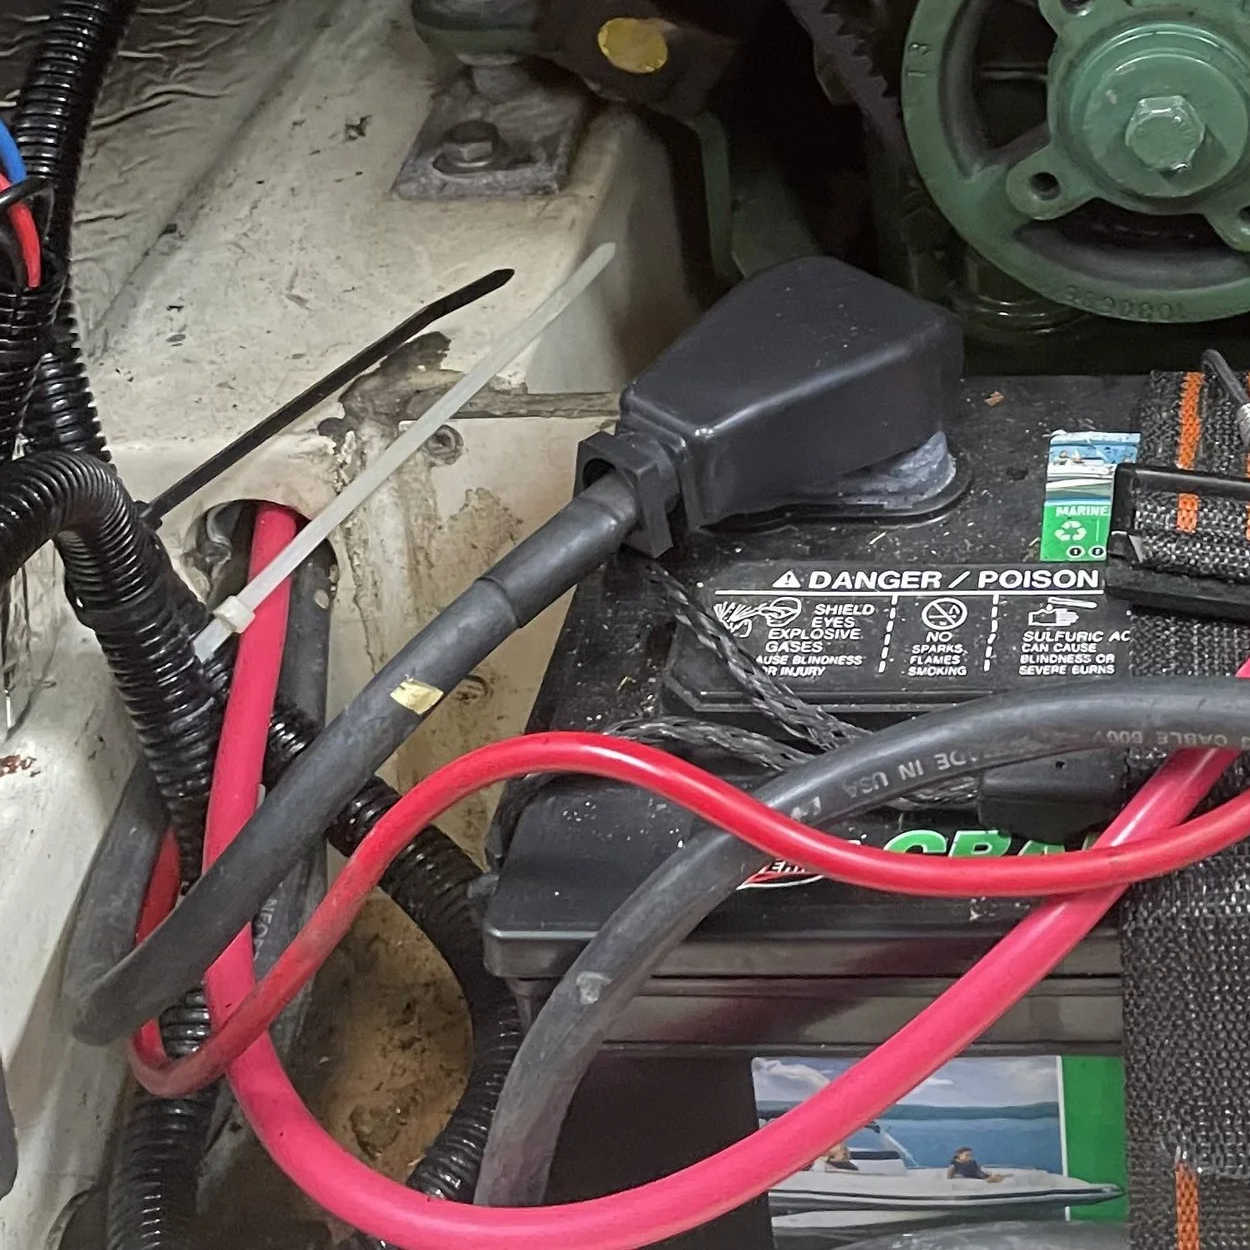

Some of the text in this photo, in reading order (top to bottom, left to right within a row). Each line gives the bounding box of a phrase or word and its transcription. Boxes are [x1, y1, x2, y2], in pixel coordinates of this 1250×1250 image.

[1055, 505, 1109, 518] MARINE
[808, 570, 943, 590] DANGER
[977, 568, 1099, 589] POISON
[814, 603, 876, 616] SHIELD
[811, 616, 855, 629] EYES
[768, 628, 862, 640] EXPLOSIVE
[926, 632, 952, 642] NO
[1022, 631, 1104, 642] SULFURIC
[765, 641, 824, 653] GASES
[1021, 644, 1096, 653] CAN CAUSE
[792, 655, 863, 665] BLINDNESS
[909, 656, 960, 665] FLAMES
[1020, 654, 1115, 664] BLINDNESS OR
[780, 667, 826, 677] INJURY
[908, 666, 968, 676] SMOKING
[1019, 665, 1115, 675] SEVERE BURNS
[1155, 730, 1229, 747] CABLE
[898, 758, 925, 782] IN
